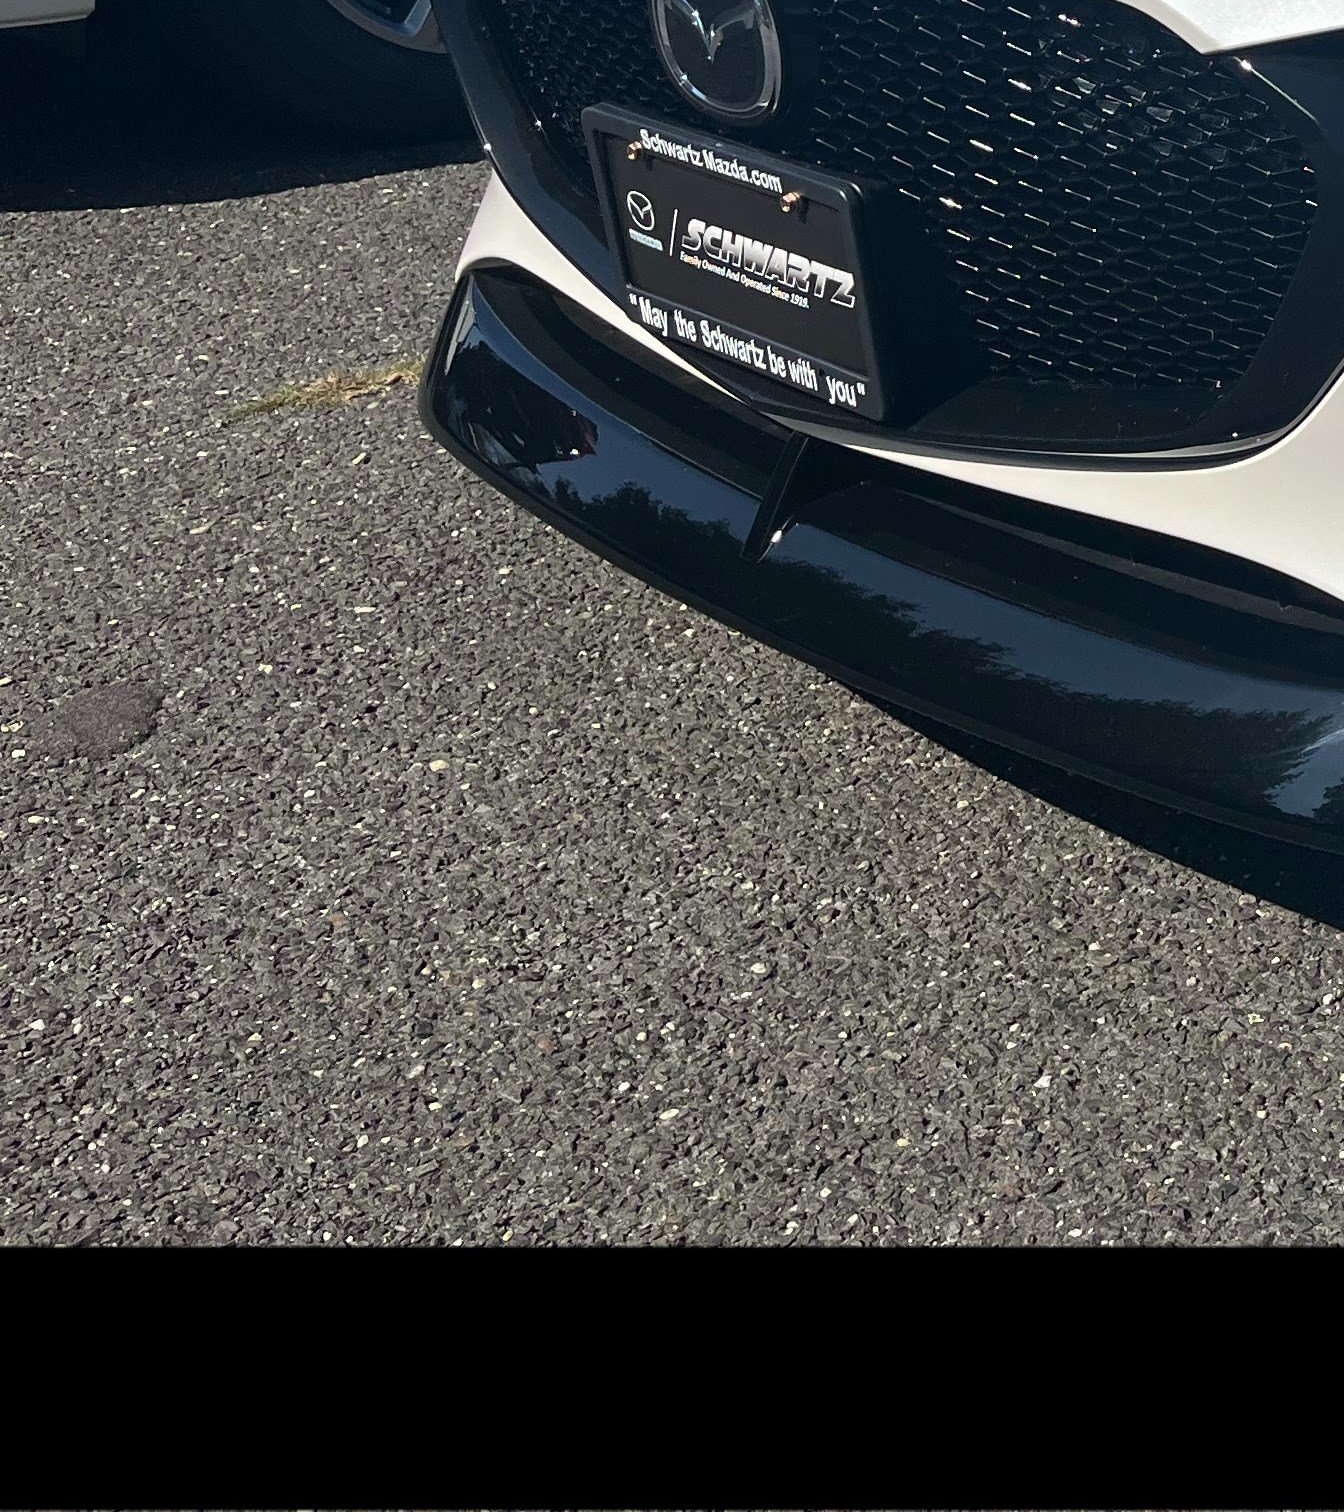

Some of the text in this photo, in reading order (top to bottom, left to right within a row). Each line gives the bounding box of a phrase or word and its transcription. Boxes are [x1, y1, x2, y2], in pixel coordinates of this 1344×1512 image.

[640, 129, 783, 193] Schwartz Mazda.com
[680, 250, 702, 269] Family
[702, 259, 726, 277] Owned
[726, 269, 740, 282] And
[740, 274, 771, 294] Operated
[771, 285, 790, 301] Since
[682, 219, 856, 308] SCHWARTZ
[674, 309, 697, 342] the
[700, 319, 766, 369] Schwartz
[767, 345, 786, 378] be
[788, 357, 818, 391] with
